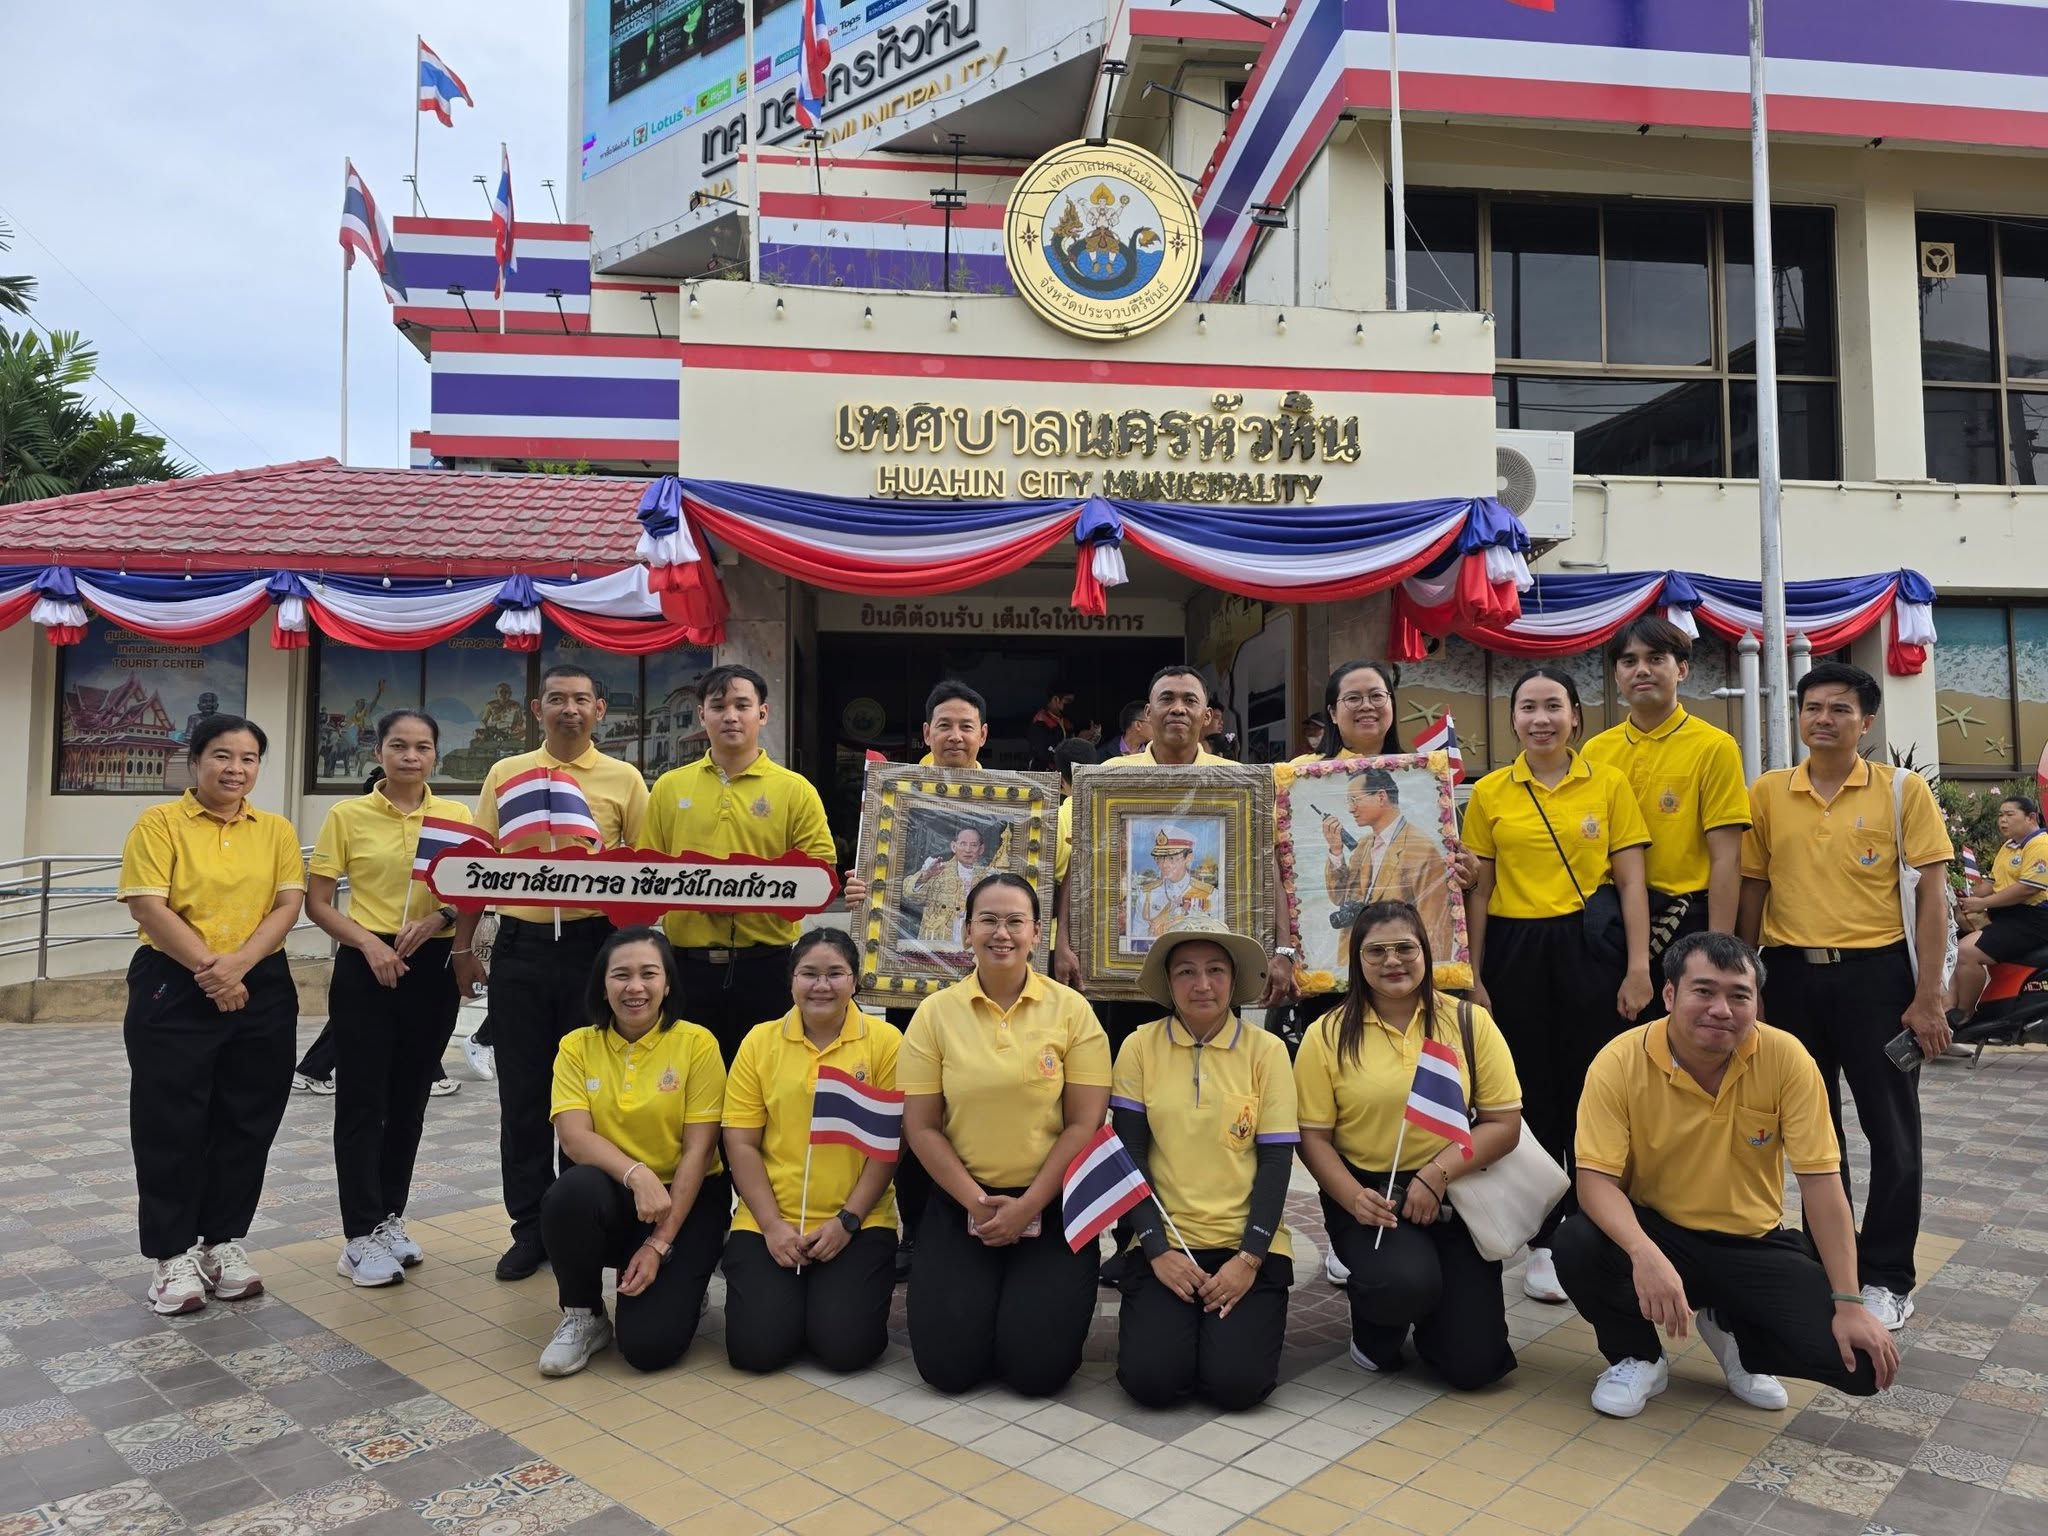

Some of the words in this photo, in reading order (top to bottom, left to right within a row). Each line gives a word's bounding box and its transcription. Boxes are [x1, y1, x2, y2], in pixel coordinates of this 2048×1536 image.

[839, 13, 862, 30] Tops
[651, 104, 692, 135] Lotus's
[1039, 276, 1169, 320] จังหวัดประจวบคีรีขันธ์
[835, 391, 1362, 463] เทศบาลนครหัวหิน
[877, 465, 1006, 497] HUAHIN
[1017, 469, 1093, 498] CITY
[1103, 468, 1323, 504] MUNICIPALITY
[860, 603, 983, 630] ยินดีต้อนรับ
[993, 604, 1145, 631] เต็มใจให้บรการ
[112, 658, 160, 669] TOURIST
[162, 659, 205, 669] CENTER
